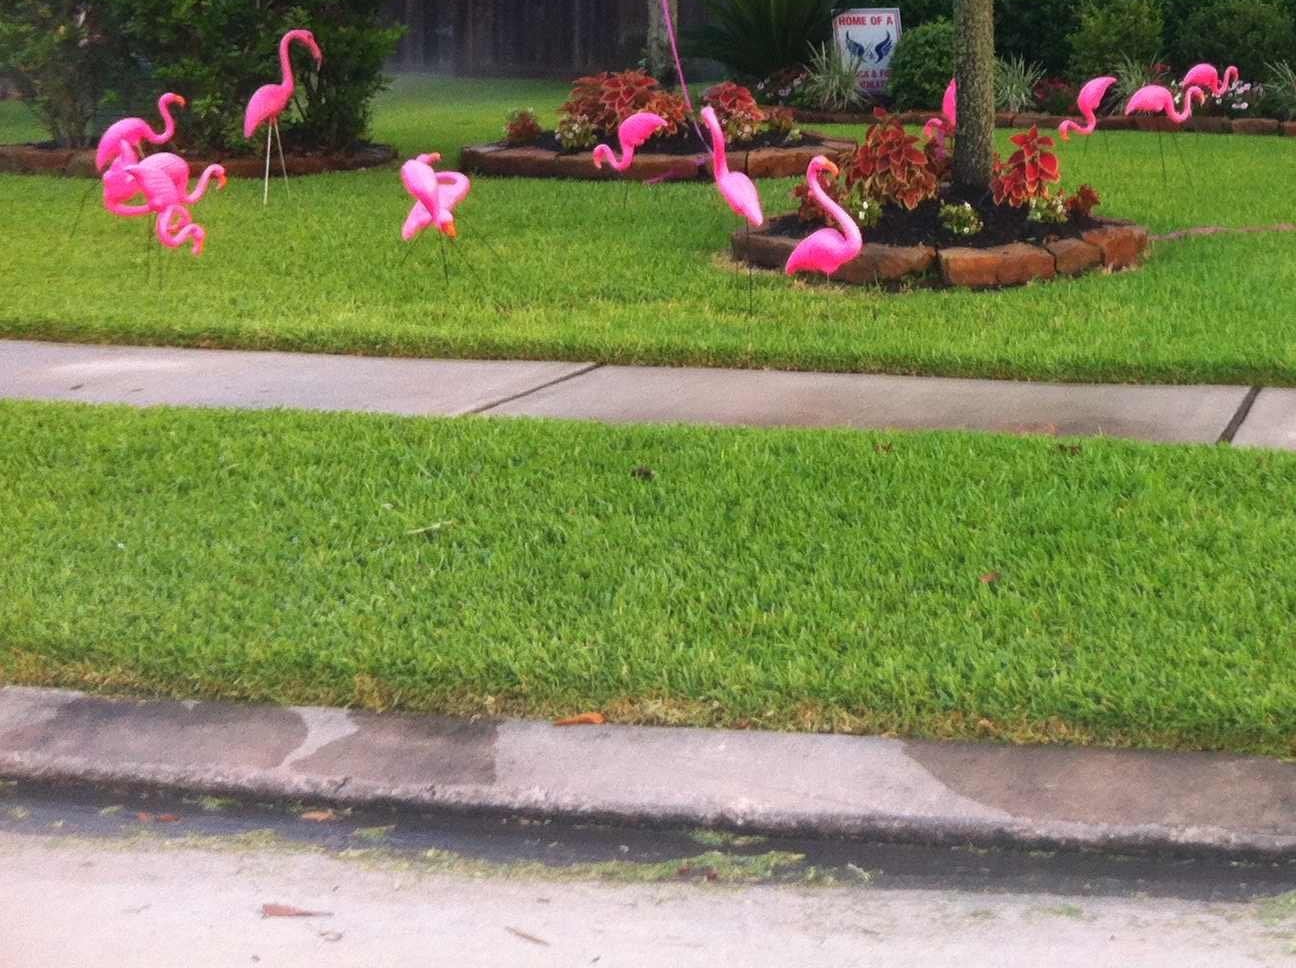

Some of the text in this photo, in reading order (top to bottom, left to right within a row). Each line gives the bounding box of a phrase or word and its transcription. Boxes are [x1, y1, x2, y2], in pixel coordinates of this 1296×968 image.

[838, 15, 894, 25] HOME OF A
